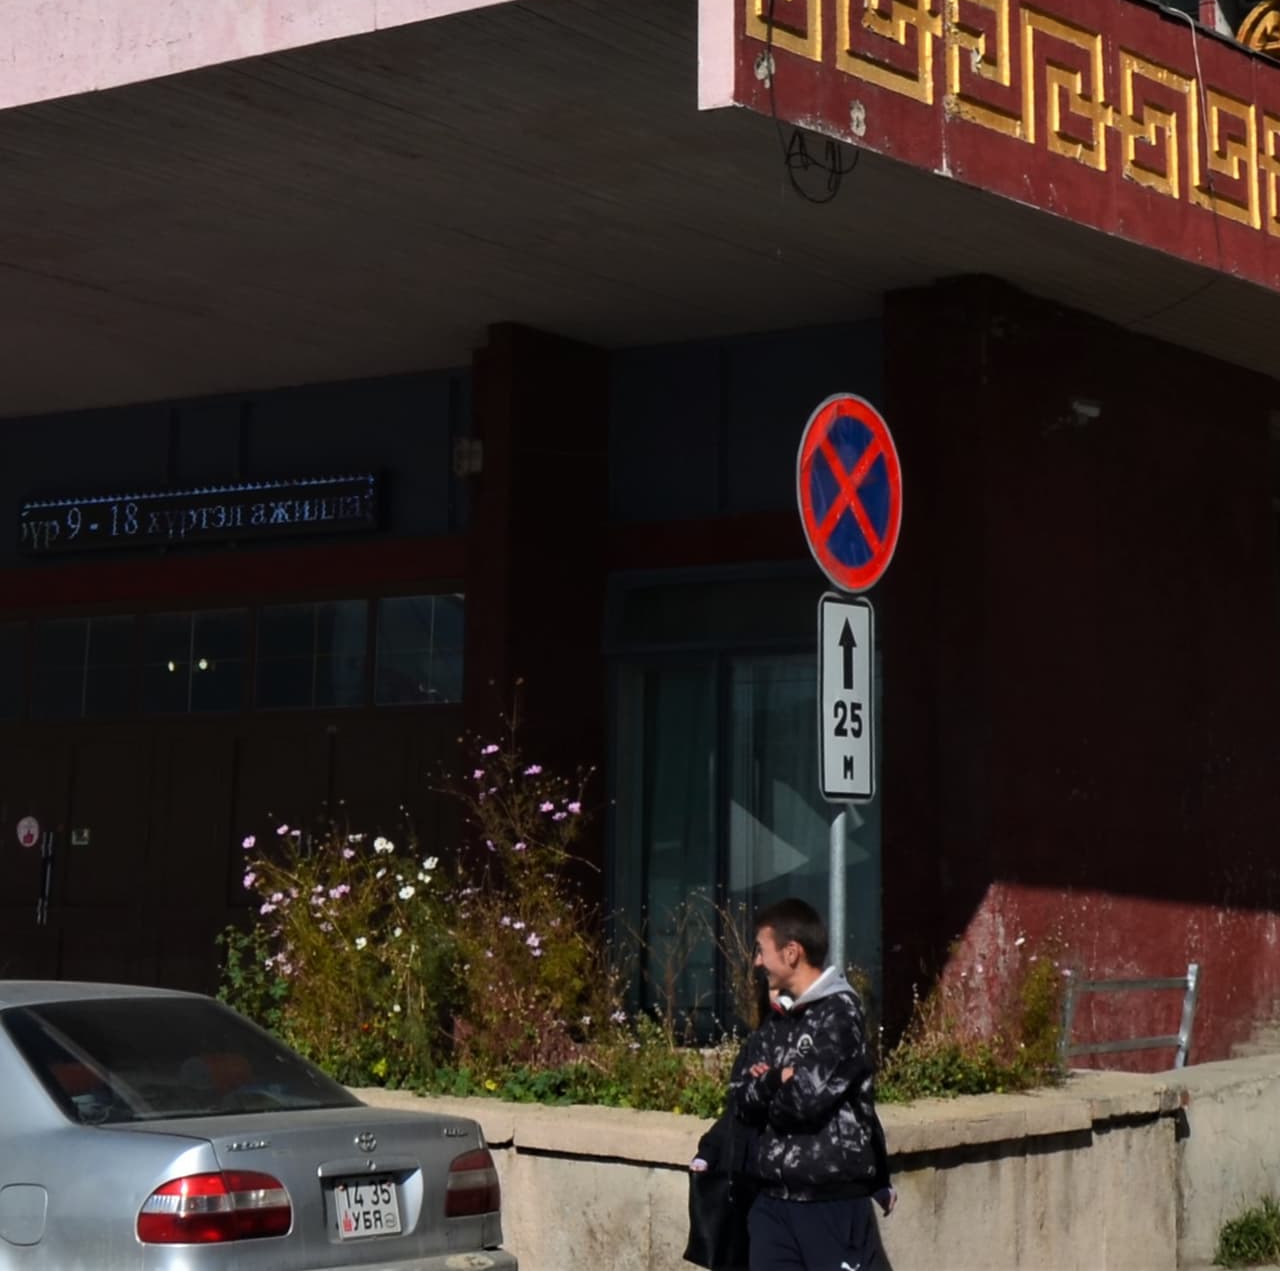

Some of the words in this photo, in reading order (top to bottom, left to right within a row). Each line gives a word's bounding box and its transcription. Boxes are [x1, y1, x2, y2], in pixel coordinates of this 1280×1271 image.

[66, 507, 82, 540] 9
[111, 503, 139, 537] 18
[833, 700, 863, 738] 25
[345, 1181, 364, 1208] 14
[369, 1179, 392, 1206] 35
[352, 1210, 383, 1231] УБЯ
